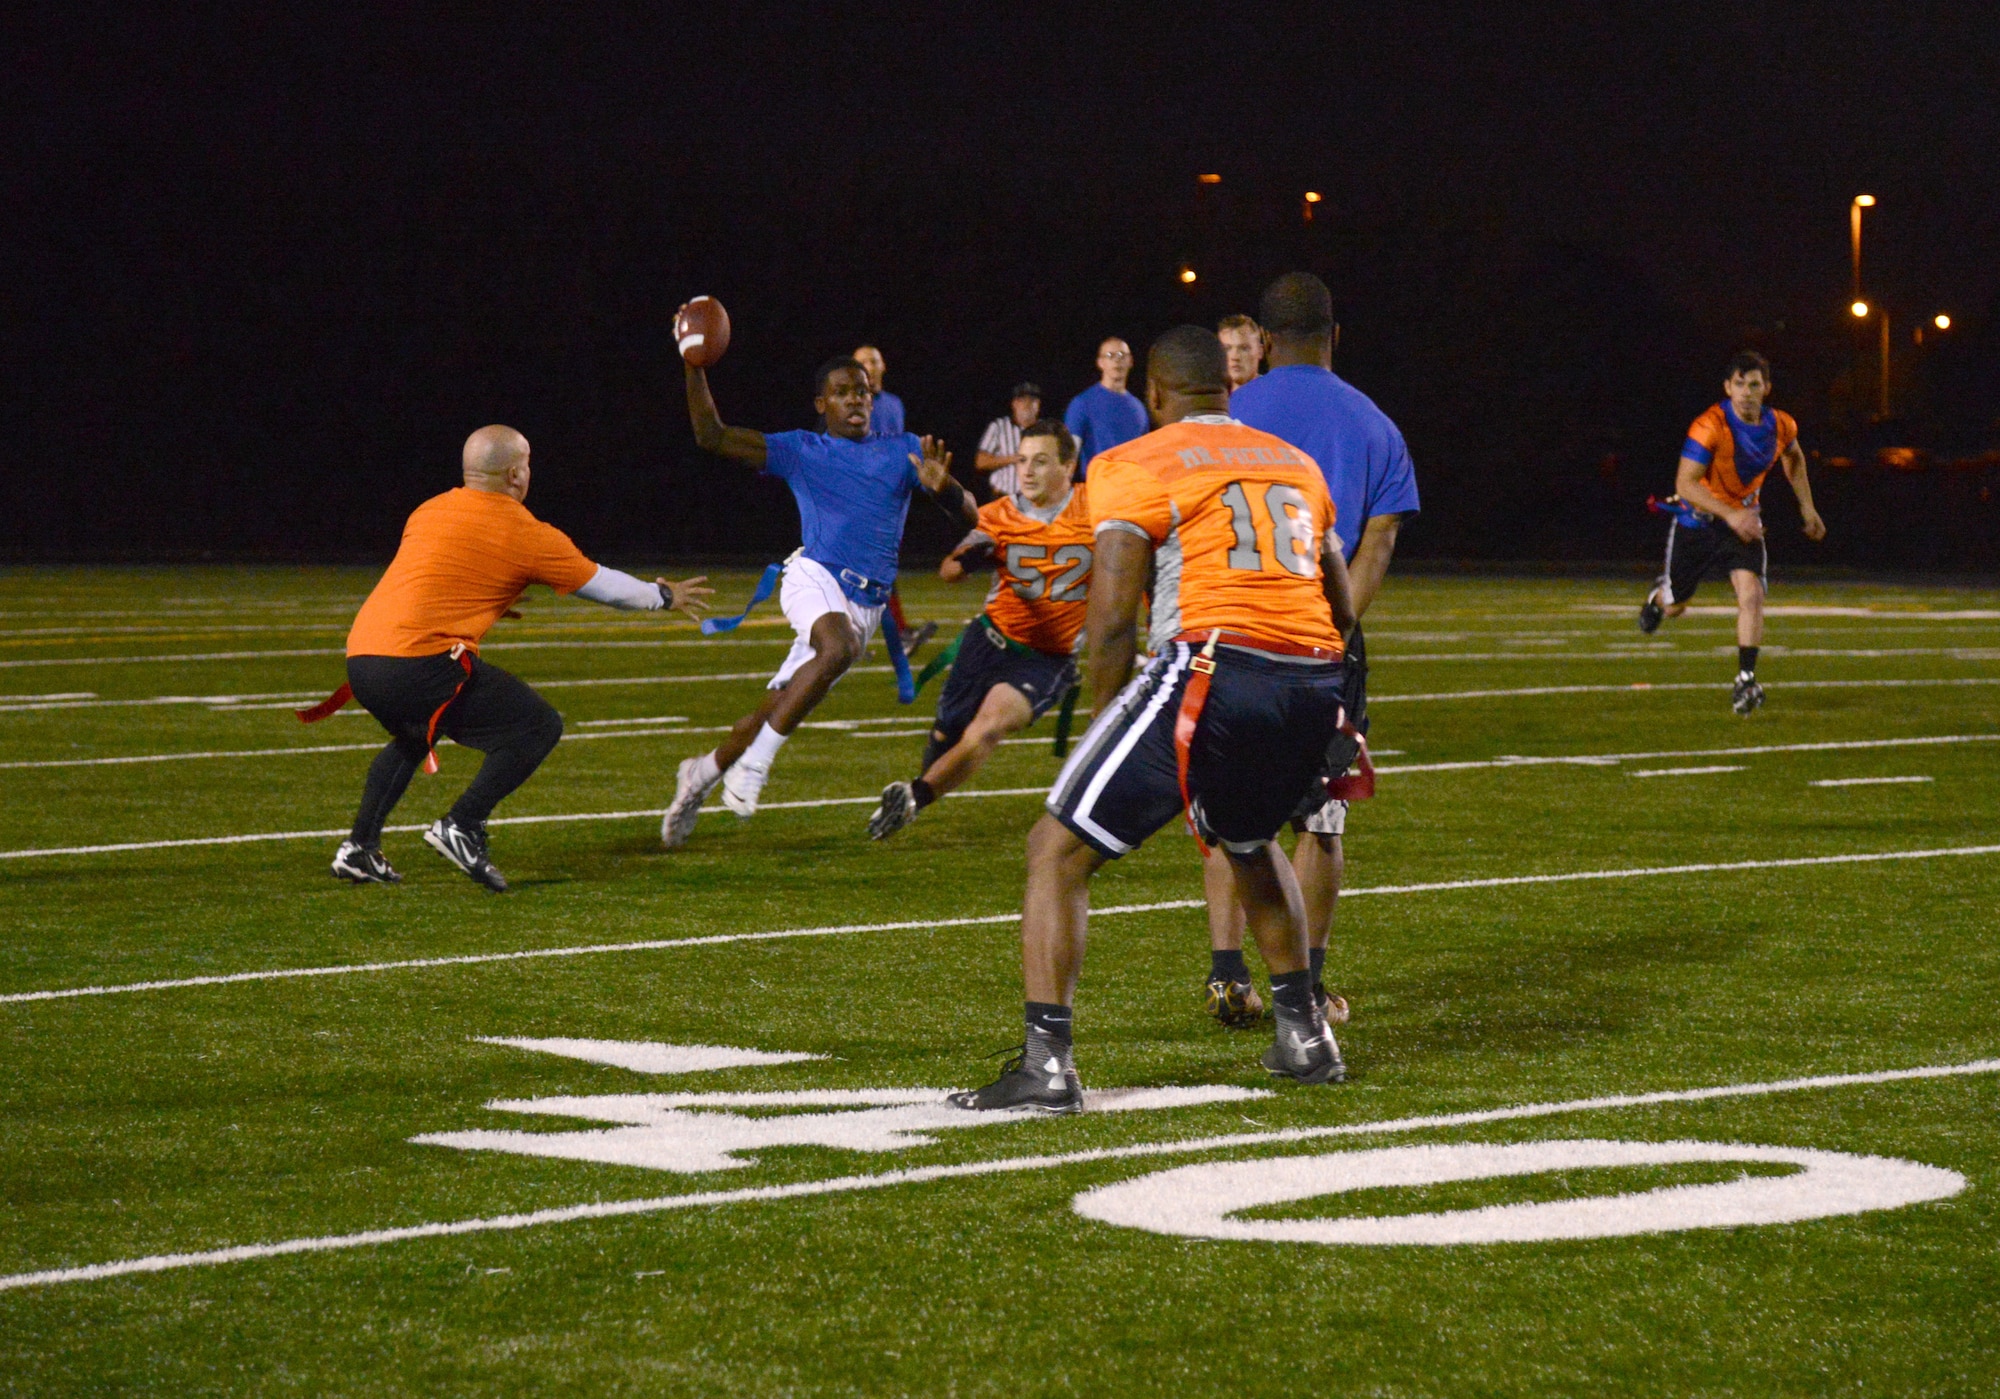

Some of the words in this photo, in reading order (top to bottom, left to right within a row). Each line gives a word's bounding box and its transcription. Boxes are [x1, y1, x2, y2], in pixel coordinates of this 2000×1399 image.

[1177, 446, 1219, 468] MR.
[1220, 482, 1316, 579] 18
[1006, 544, 1093, 602] 52
